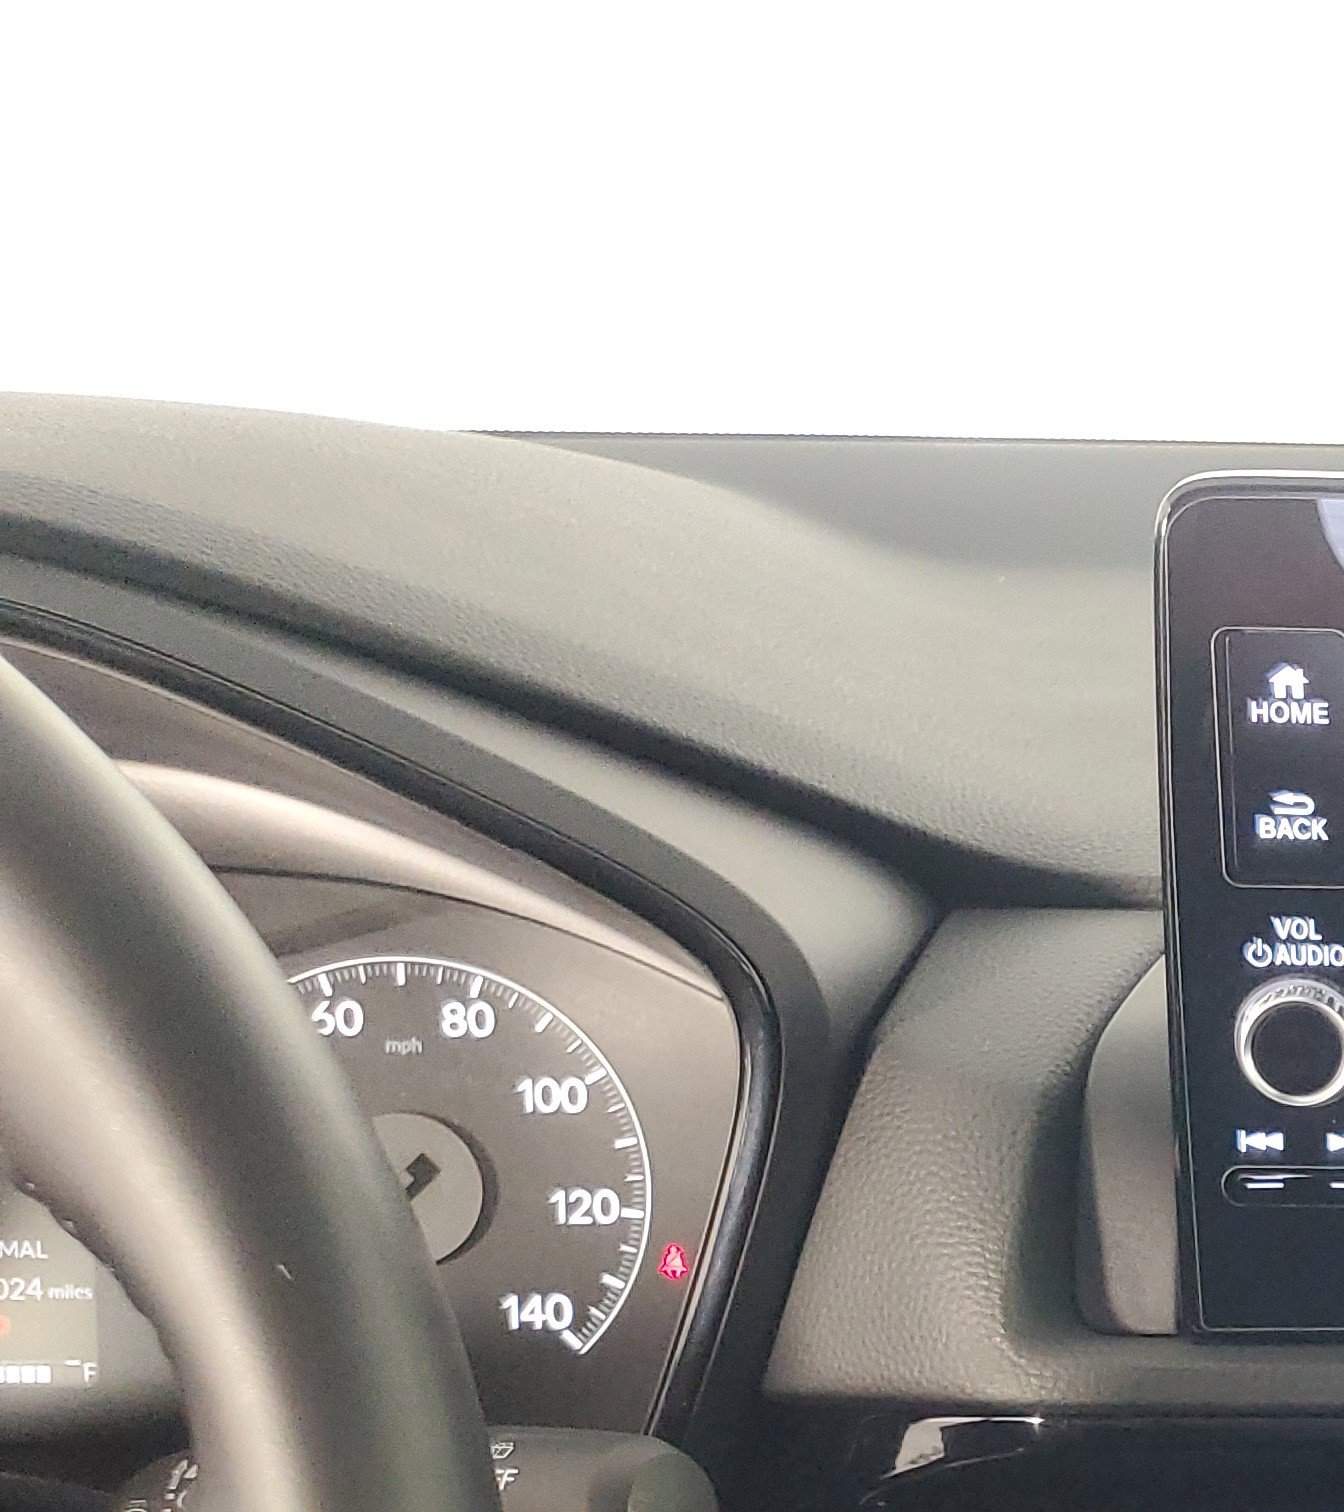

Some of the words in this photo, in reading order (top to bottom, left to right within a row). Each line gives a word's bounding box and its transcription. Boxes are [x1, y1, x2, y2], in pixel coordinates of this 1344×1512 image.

[1247, 697, 1331, 726] HOME
[1255, 814, 1329, 844] BACK
[1271, 915, 1323, 945] VOL
[311, 1000, 364, 1037] 60
[440, 1000, 496, 1039] 80
[385, 1036, 424, 1056] mph
[515, 1075, 588, 1115] 100
[549, 1188, 619, 1226] 120
[49, 1282, 93, 1301] miles
[500, 1292, 572, 1333] 140
[82, 1361, 98, 1383] F
